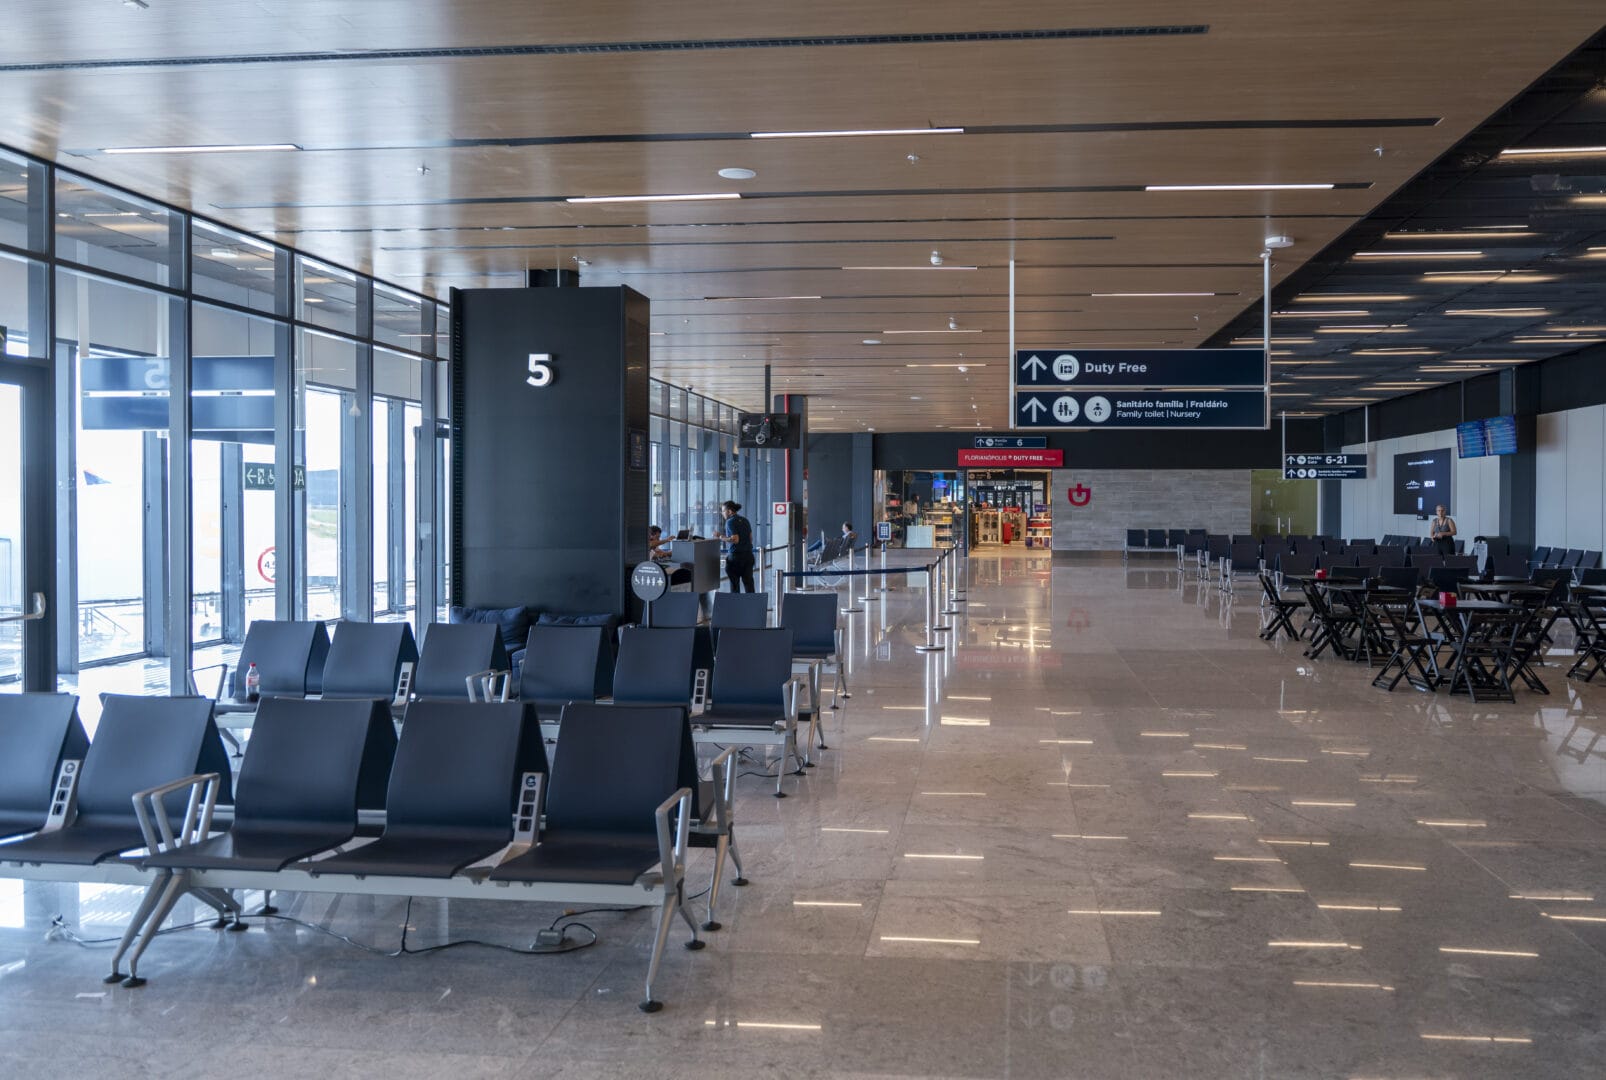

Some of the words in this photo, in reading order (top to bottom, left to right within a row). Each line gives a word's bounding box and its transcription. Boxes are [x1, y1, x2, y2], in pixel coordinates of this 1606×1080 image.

[527, 353, 553, 386] 5
[1085, 363, 1115, 374] Duty
[1119, 363, 1147, 373] Free
[1116, 400, 1154, 408] Sanitário
[1155, 400, 1184, 408] família
[1190, 400, 1228, 408] Fraldário
[1116, 410, 1142, 419] Family
[1144, 410, 1164, 418] toilet
[1170, 410, 1201, 419] Nursery
[1325, 455, 1347, 464] 6-21
